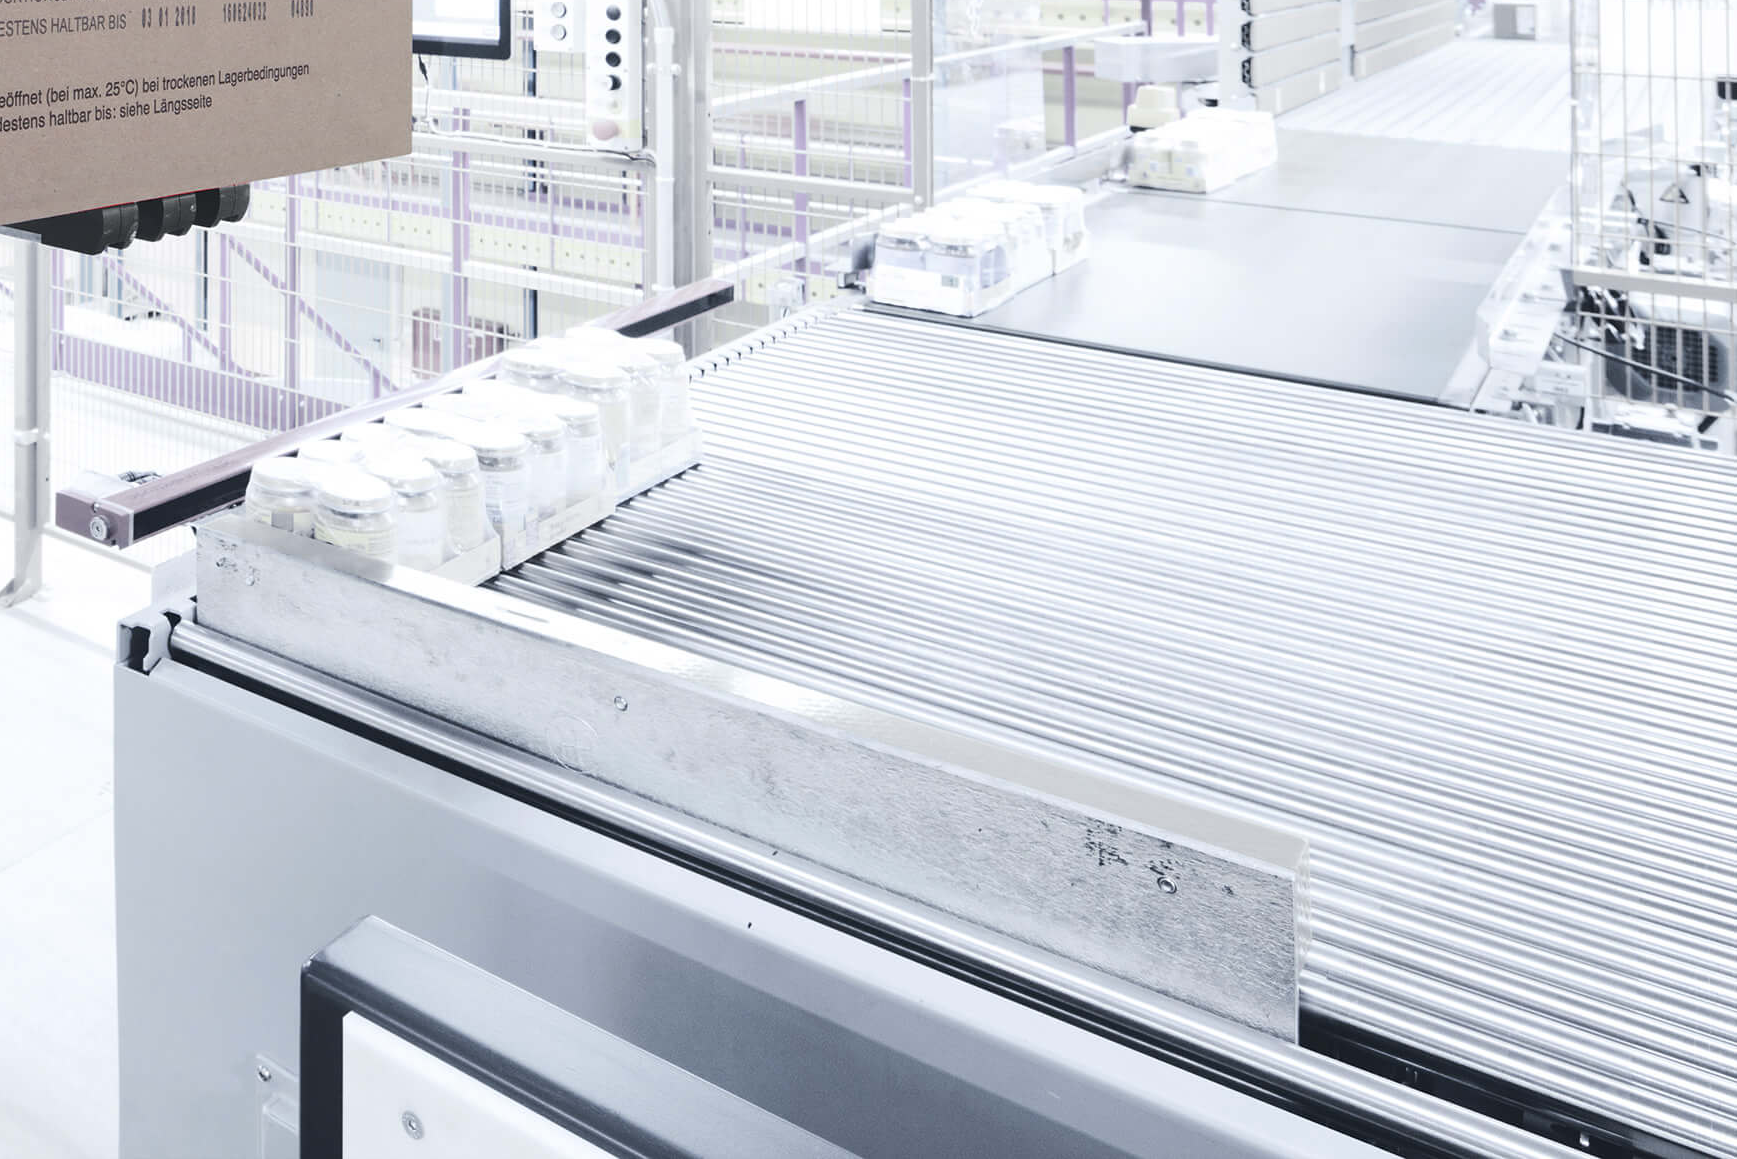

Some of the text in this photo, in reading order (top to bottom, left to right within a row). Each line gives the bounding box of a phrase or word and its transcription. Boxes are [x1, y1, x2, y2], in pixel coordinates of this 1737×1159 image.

[50, 15, 106, 35] HALTBAR
[108, 13, 127, 30] BIS
[141, 7, 152, 28] 03
[158, 6, 169, 27] 01
[46, 88, 69, 106] (bei
[73, 86, 102, 102] max.
[105, 79, 139, 99] 25°C)
[142, 79, 160, 93] bei
[162, 74, 215, 91] trockenen
[218, 62, 310, 87] Lagerbedingungen
[49, 111, 91, 128] haltbar
[94, 106, 116, 121] bis:
[119, 103, 150, 118] siehe
[153, 96, 213, 117] Längsseite
